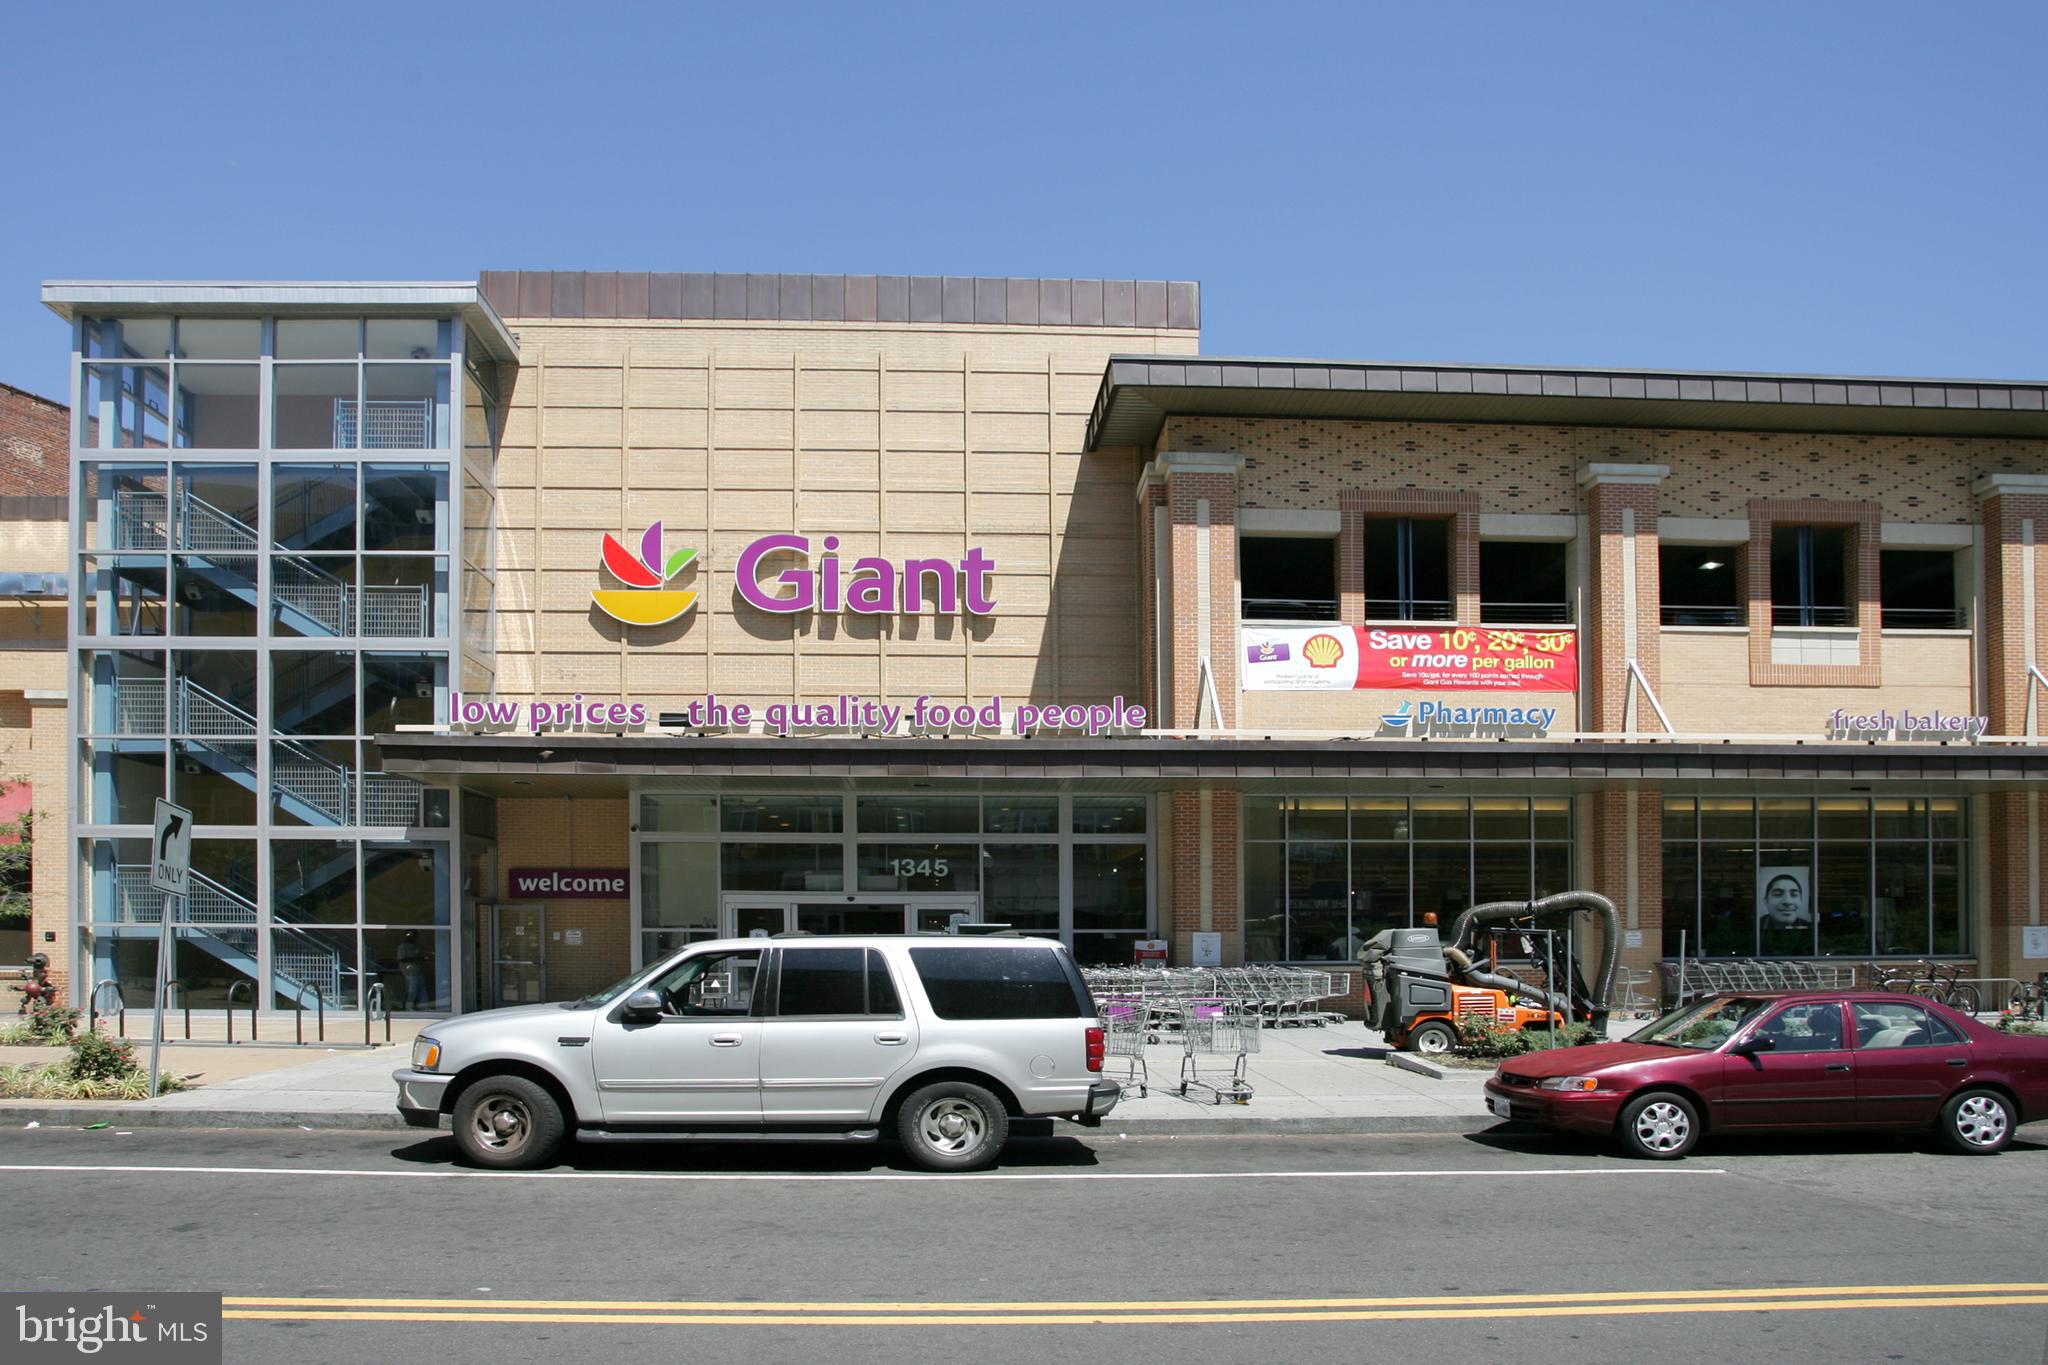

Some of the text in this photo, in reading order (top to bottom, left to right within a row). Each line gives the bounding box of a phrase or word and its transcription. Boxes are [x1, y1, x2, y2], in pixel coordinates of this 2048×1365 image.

[736, 533, 997, 615] Giant
[1369, 629, 1432, 650] Save
[1389, 654, 1554, 672] or more per gallon
[452, 692, 1146, 735] low prices the quality food people
[1418, 701, 1556, 729] Pharmacy
[1832, 708, 1989, 736] fresh bakery
[158, 864, 183, 884] ONLY
[890, 858, 949, 878] 1345
[518, 872, 625, 893] welcome
